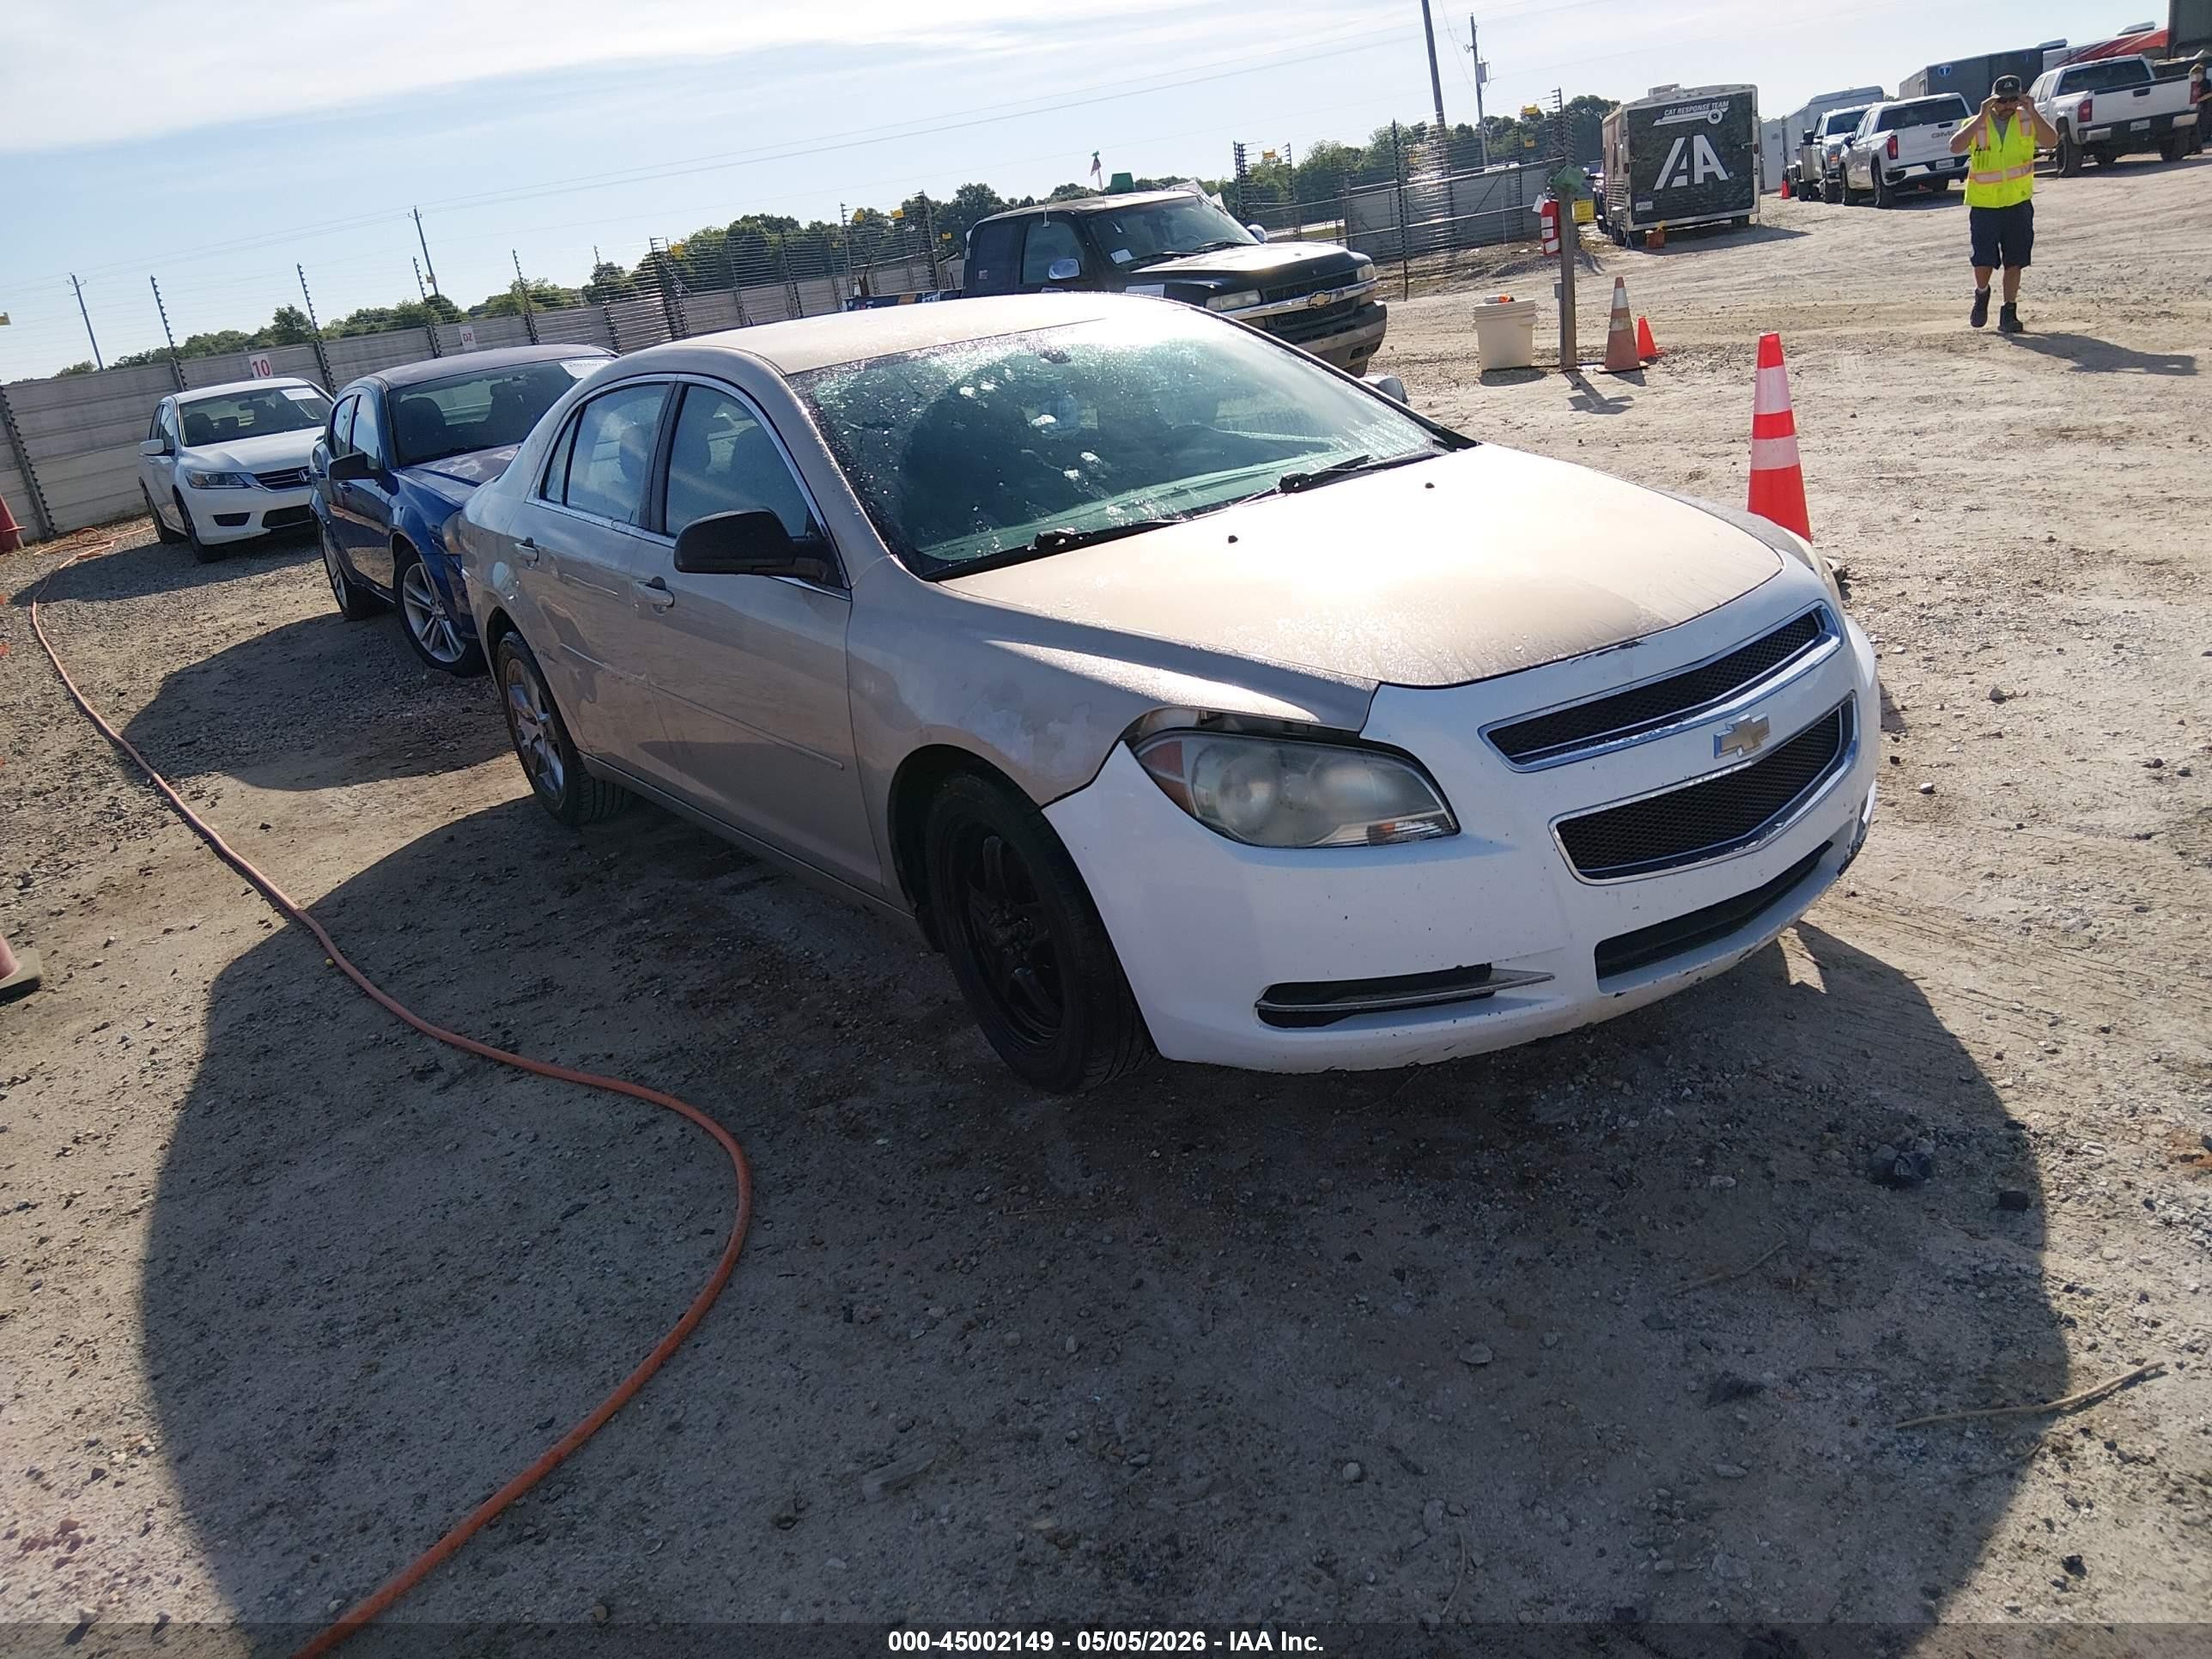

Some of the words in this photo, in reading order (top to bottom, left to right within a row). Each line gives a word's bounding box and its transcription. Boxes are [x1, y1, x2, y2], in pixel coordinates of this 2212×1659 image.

[1677, 103, 1711, 114] RESPONSE
[1711, 100, 1729, 110] TEAM
[252, 359, 270, 378] 10
